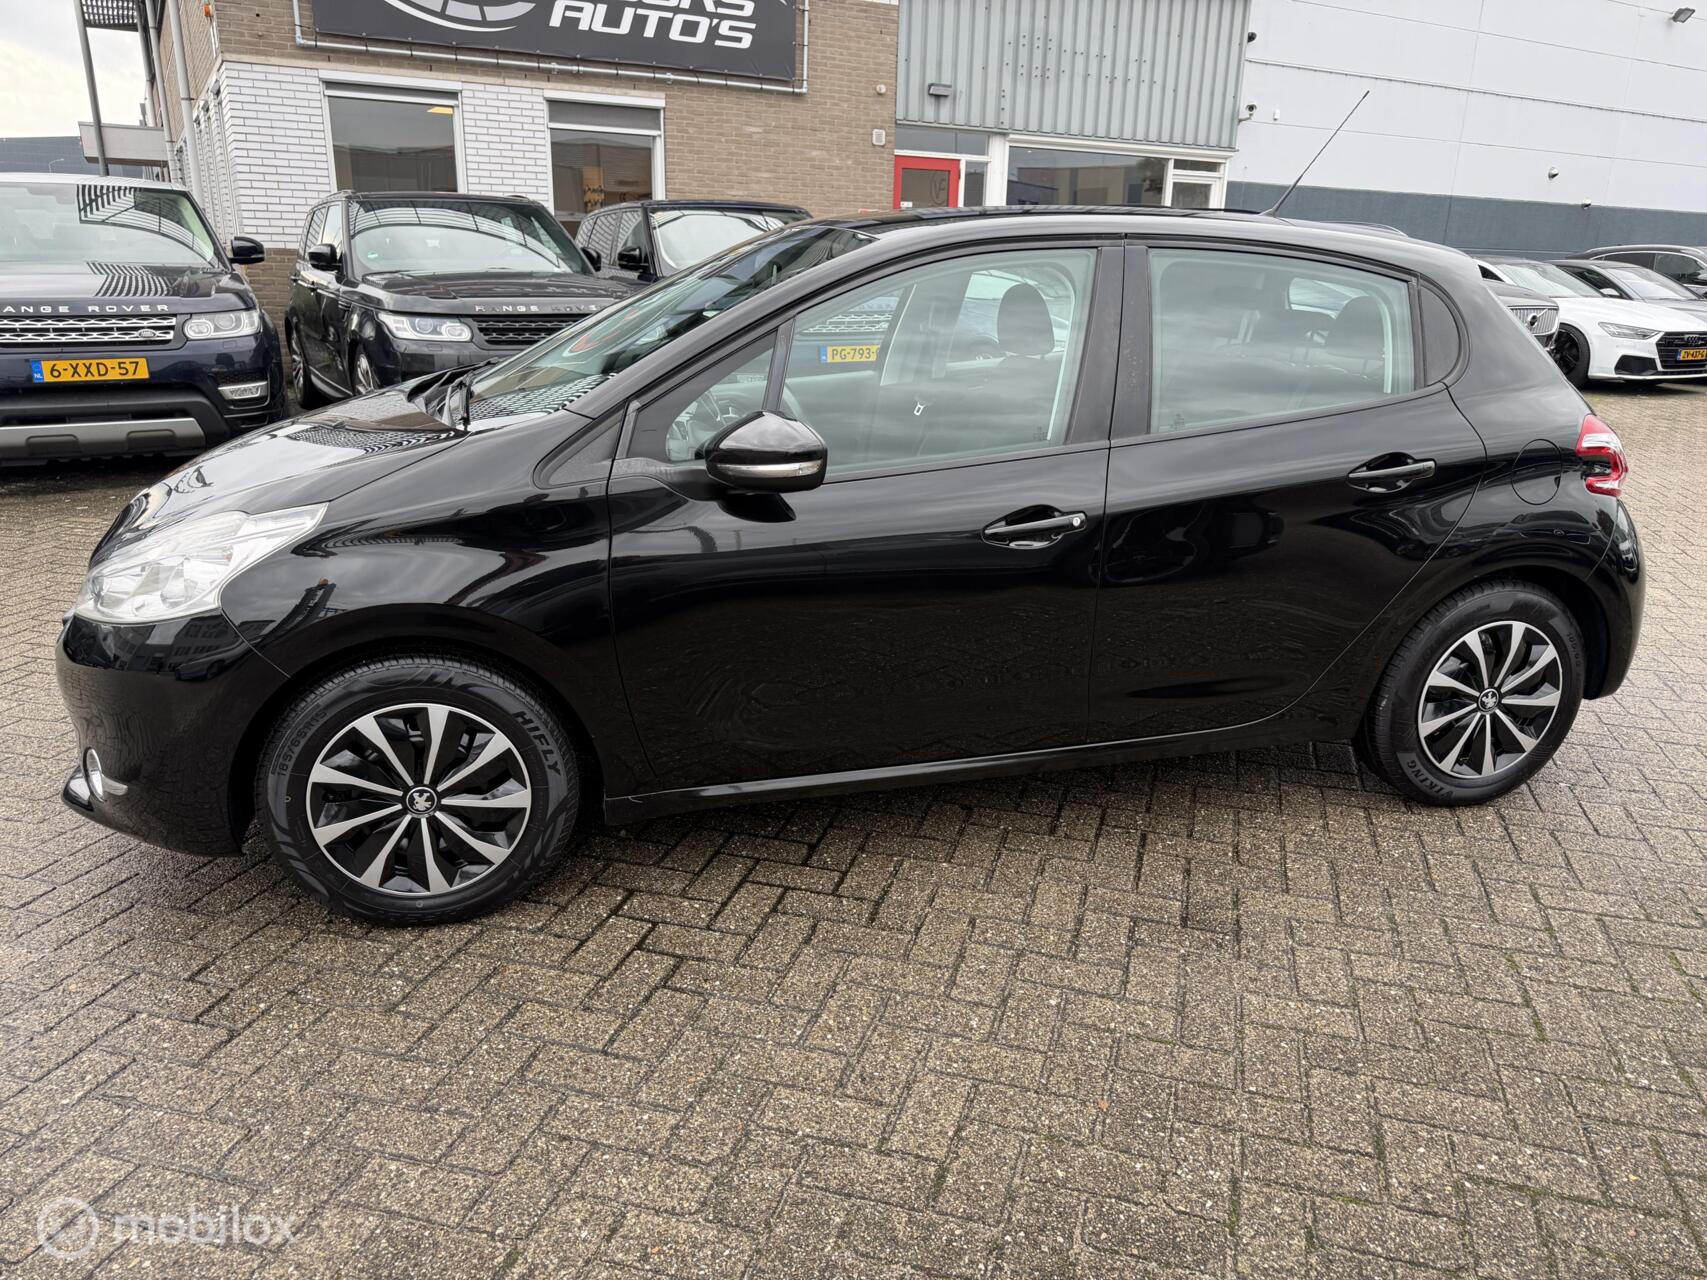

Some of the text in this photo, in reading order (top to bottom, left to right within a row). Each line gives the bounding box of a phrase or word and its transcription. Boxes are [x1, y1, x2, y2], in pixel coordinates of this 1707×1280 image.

[549, 0, 757, 49] AUTO'S
[88, 303, 169, 312] ROVER
[49, 360, 140, 379] 6-XXD-57
[511, 711, 562, 776] HIFLY
